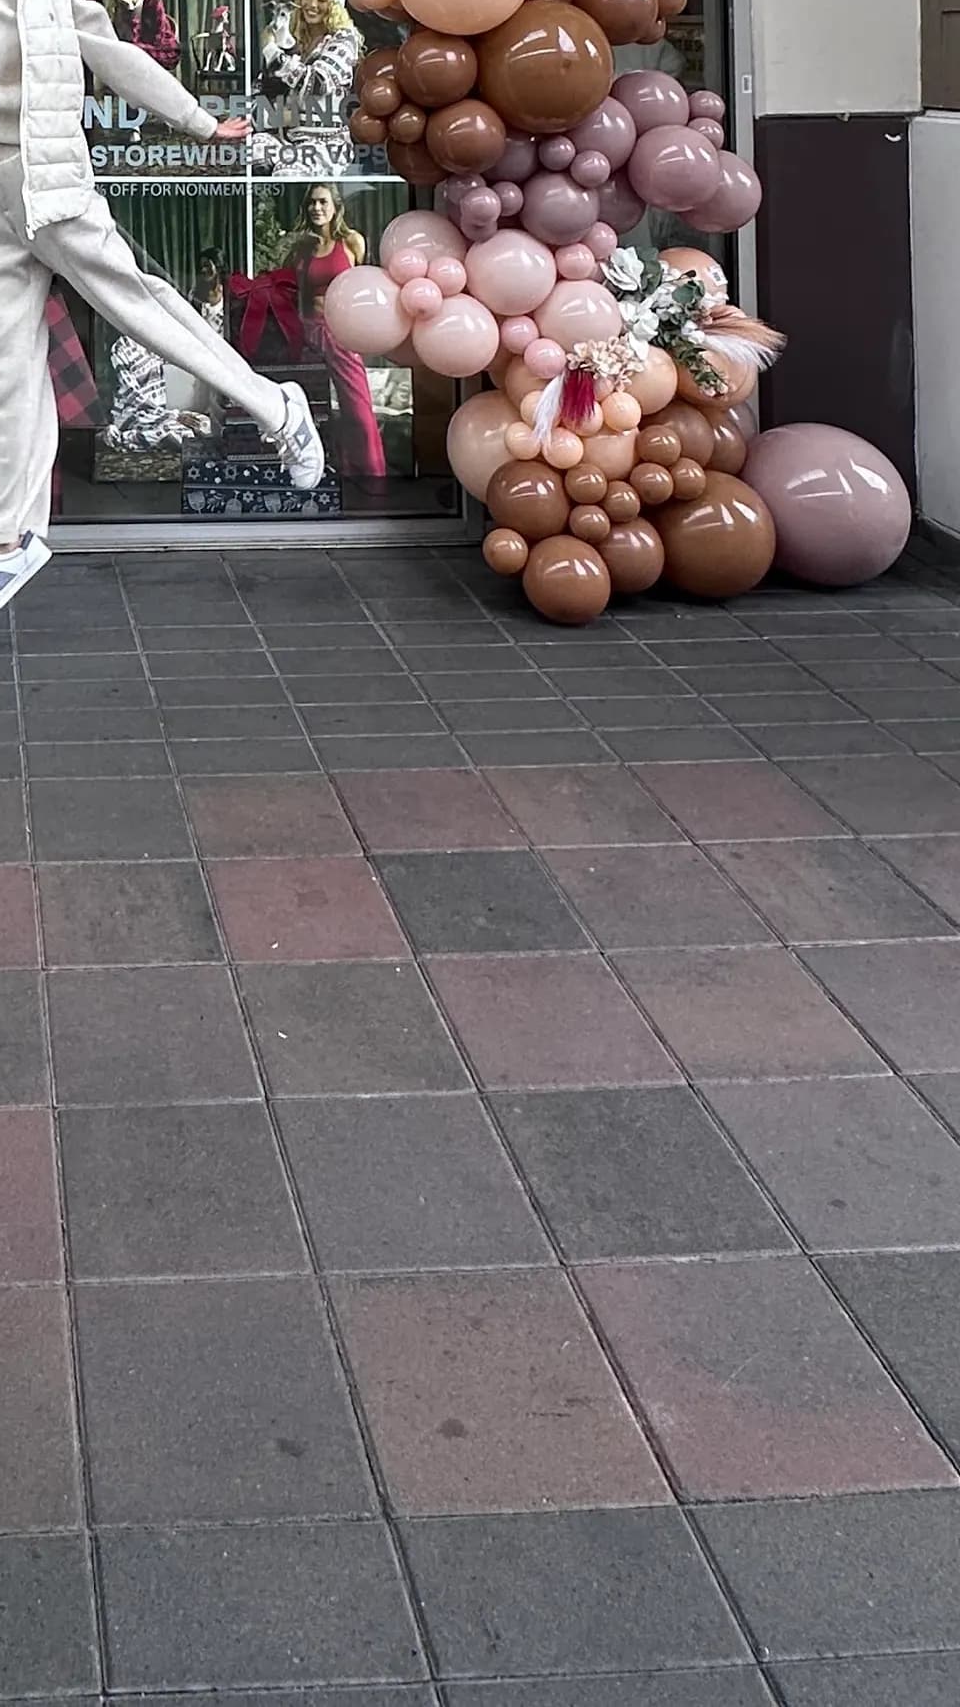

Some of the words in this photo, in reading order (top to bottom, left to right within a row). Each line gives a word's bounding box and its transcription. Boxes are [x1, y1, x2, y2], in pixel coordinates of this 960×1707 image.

[92, 144, 255, 167] STOREWIDE
[264, 145, 317, 165] FOR
[110, 183, 139, 197] OFF
[142, 183, 172, 197] FOR
